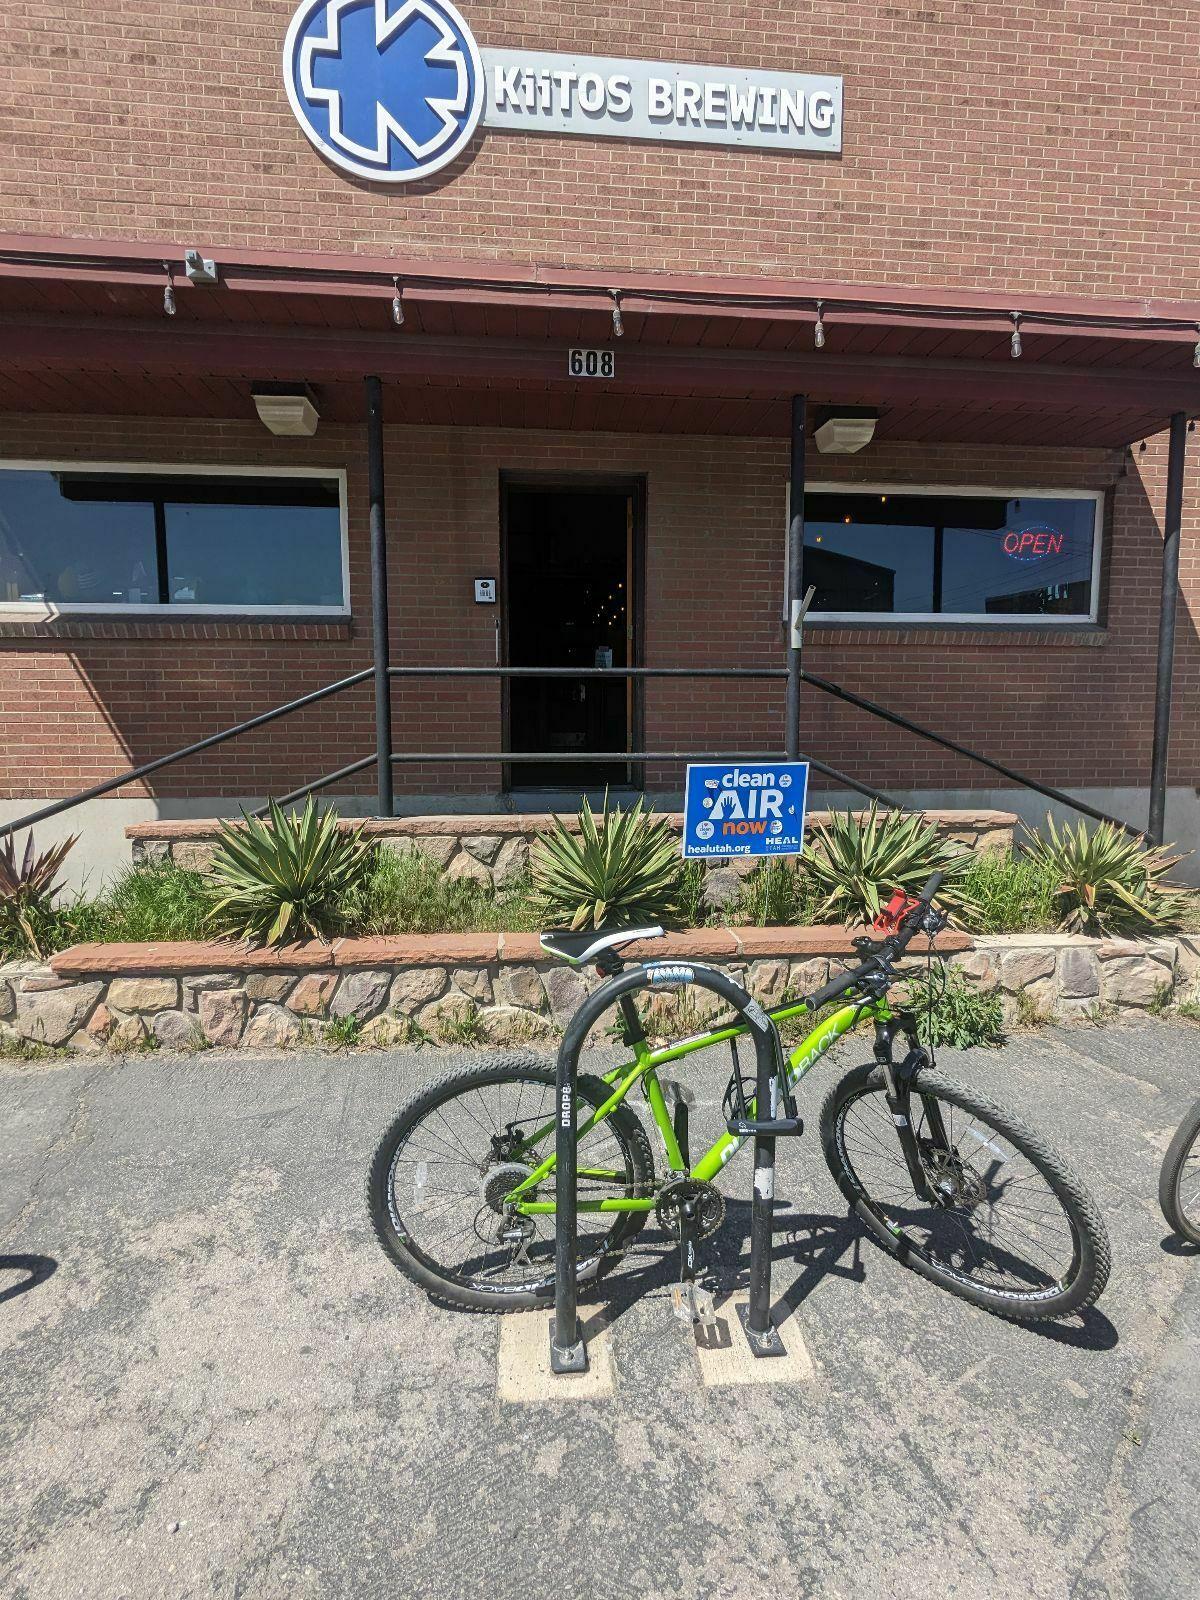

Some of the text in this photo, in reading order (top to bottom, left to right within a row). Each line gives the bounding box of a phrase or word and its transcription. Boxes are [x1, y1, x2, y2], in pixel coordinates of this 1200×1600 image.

[493, 65, 835, 130] KiiTOS BREWING
[570, 349, 613, 376] 608
[1003, 531, 1065, 554] OPEN
[722, 768, 775, 788] clean
[708, 788, 784, 820] AIR
[722, 820, 768, 836] now
[687, 843, 751, 854] healutah.org
[765, 836, 799, 845] HEAL
